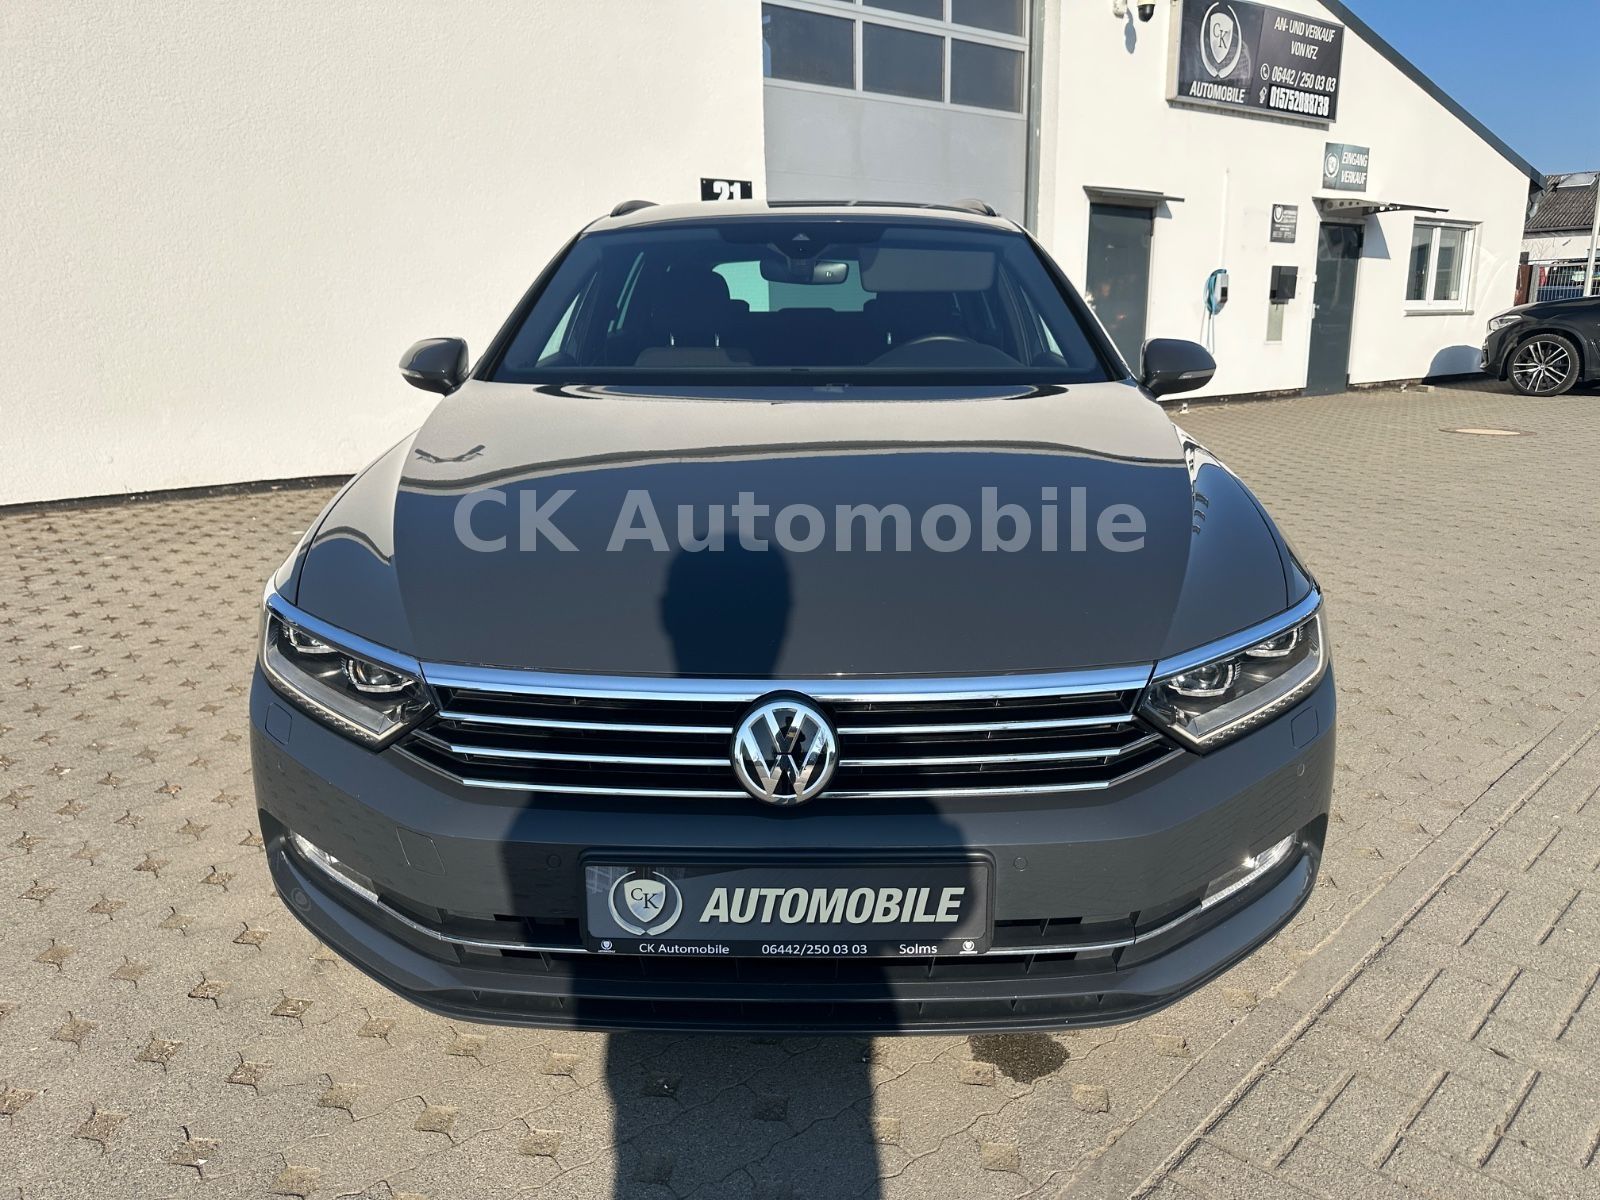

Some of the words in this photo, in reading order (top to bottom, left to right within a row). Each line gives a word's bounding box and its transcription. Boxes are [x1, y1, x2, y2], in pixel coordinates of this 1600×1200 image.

[1274, 16, 1288, 31] AN-
[1289, 20, 1305, 36] UND
[1305, 24, 1335, 42] VERKAUF
[1291, 41, 1306, 57] VON
[1305, 44, 1319, 60] KFZ
[1272, 66, 1296, 85] 06442
[1300, 72, 1315, 88] 250
[1315, 75, 1325, 90] 03
[1326, 77, 1336, 92] 03
[1189, 80, 1246, 103] AUTOMOBILE
[1342, 152, 1368, 167] EINGANG
[1341, 170, 1367, 185] VERKAUF
[713, 181, 741, 200] 21
[699, 887, 965, 924] AUTOMOBILE
[639, 943, 655, 953] CK
[658, 943, 730, 954] Automobile
[761, 944, 830, 956] 06442/250
[833, 944, 849, 955] 03
[852, 944, 868, 955] 03
[899, 943, 938, 955] Solms
